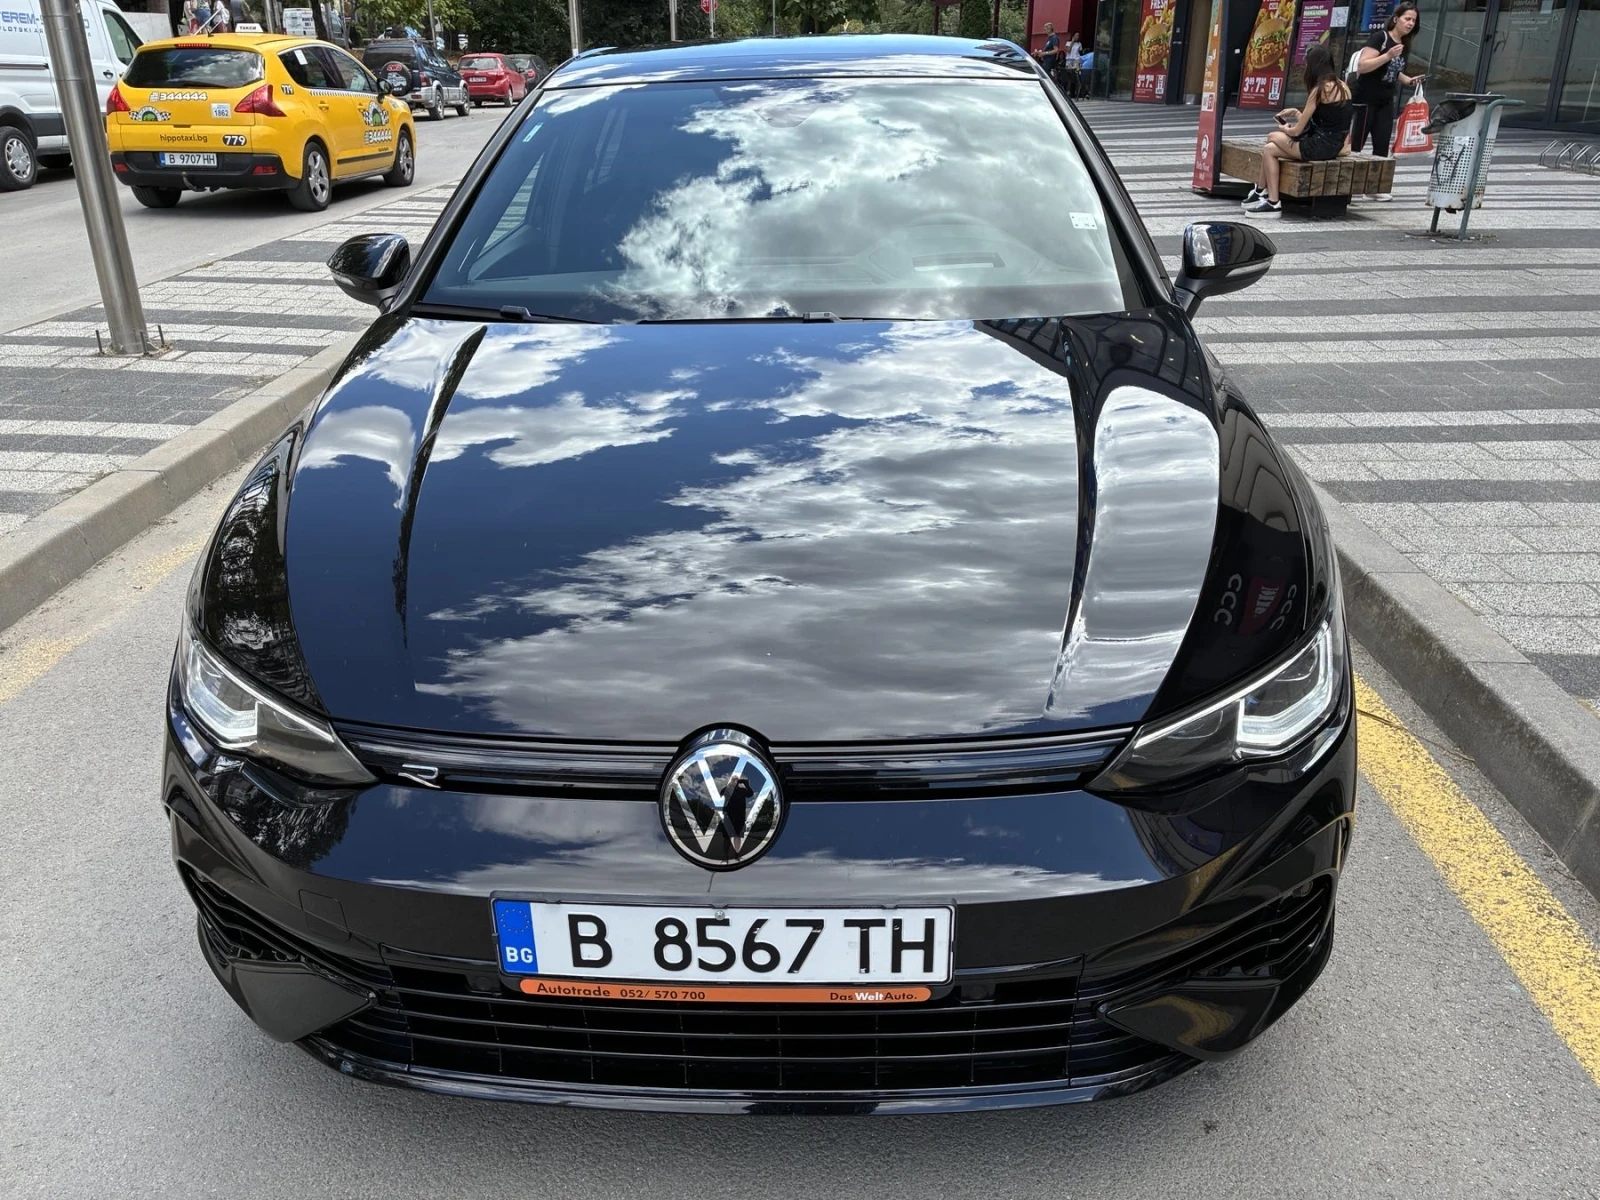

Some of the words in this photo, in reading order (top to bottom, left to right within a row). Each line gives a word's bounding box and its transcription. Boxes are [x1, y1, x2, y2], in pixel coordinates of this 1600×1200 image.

[159, 91, 208, 101] 344444
[214, 109, 229, 117] 1862
[160, 134, 208, 143] hippotaxi.bg
[224, 135, 246, 146] 779
[169, 154, 176, 164] B
[179, 154, 201, 164] 9707
[203, 154, 216, 165] HH
[567, 913, 613, 969] B
[653, 917, 825, 973] 8567
[843, 918, 935, 974] TH
[505, 946, 534, 964] BG
[536, 982, 611, 998] Autotrade
[619, 988, 650, 999] 052/
[654, 990, 678, 1000] 570
[681, 990, 706, 1001] 700
